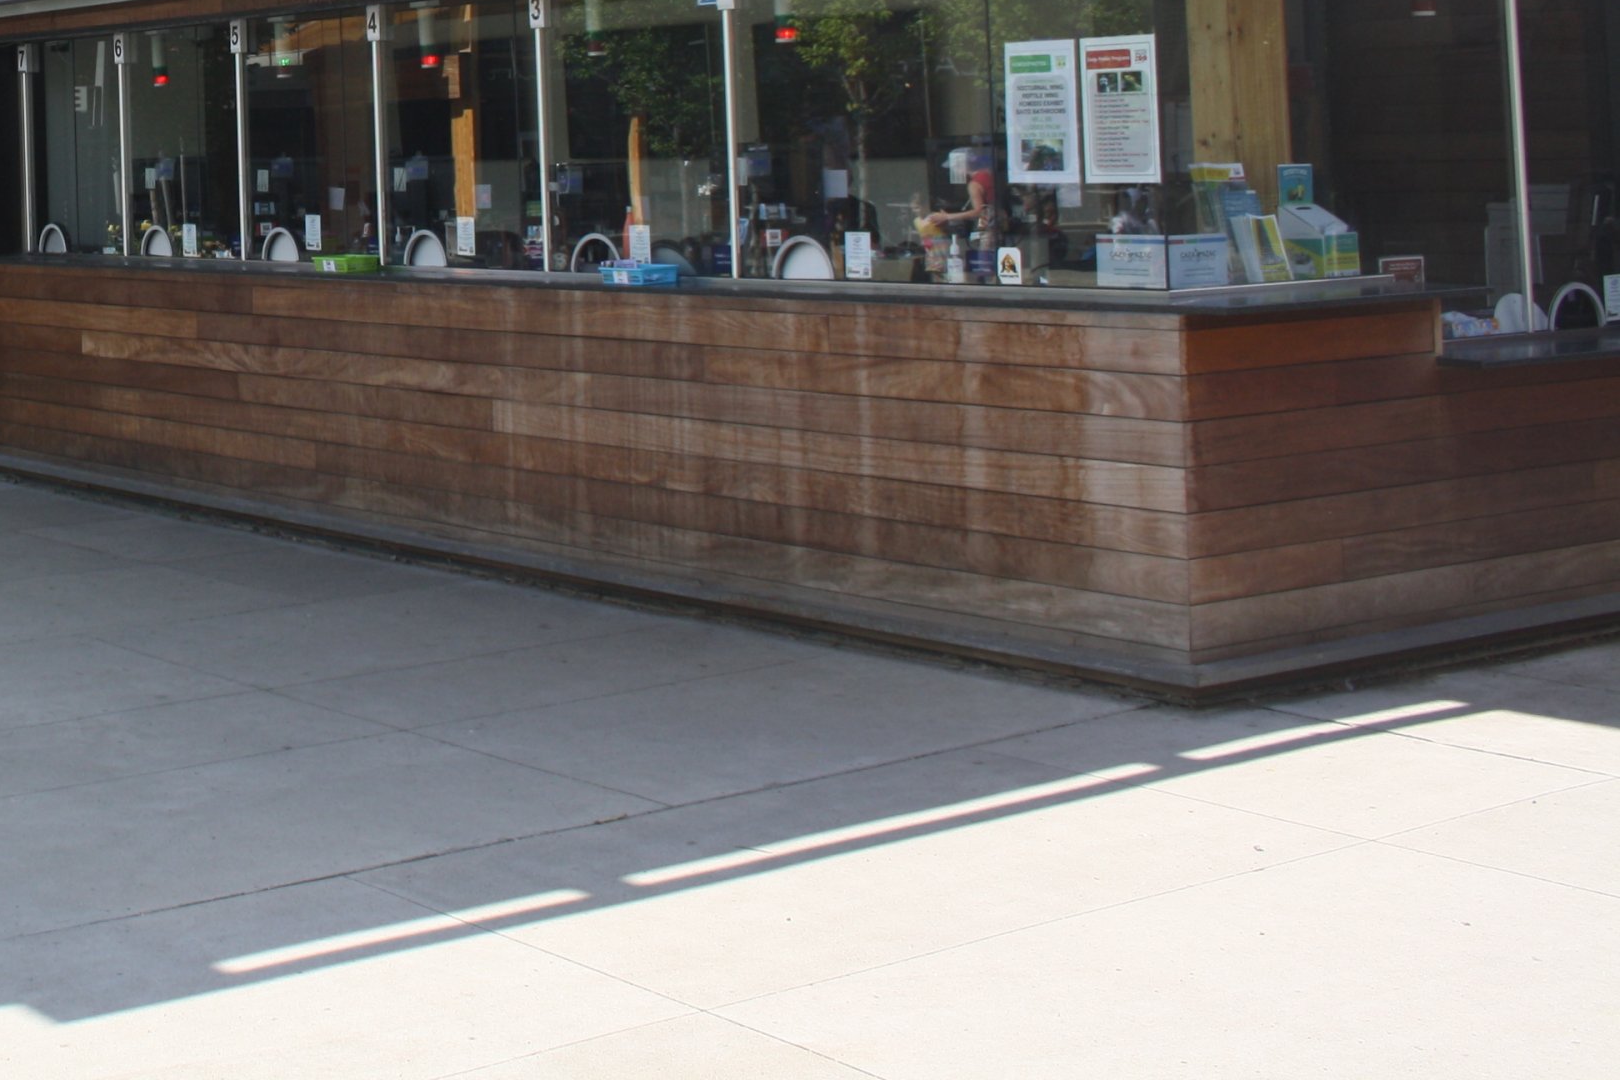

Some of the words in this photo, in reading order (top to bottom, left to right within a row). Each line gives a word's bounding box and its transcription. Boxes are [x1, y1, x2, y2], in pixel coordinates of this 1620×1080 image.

[367, 12, 377, 33] 4
[230, 25, 239, 46] 5
[114, 38, 122, 57] 6
[18, 51, 26, 67] 7
